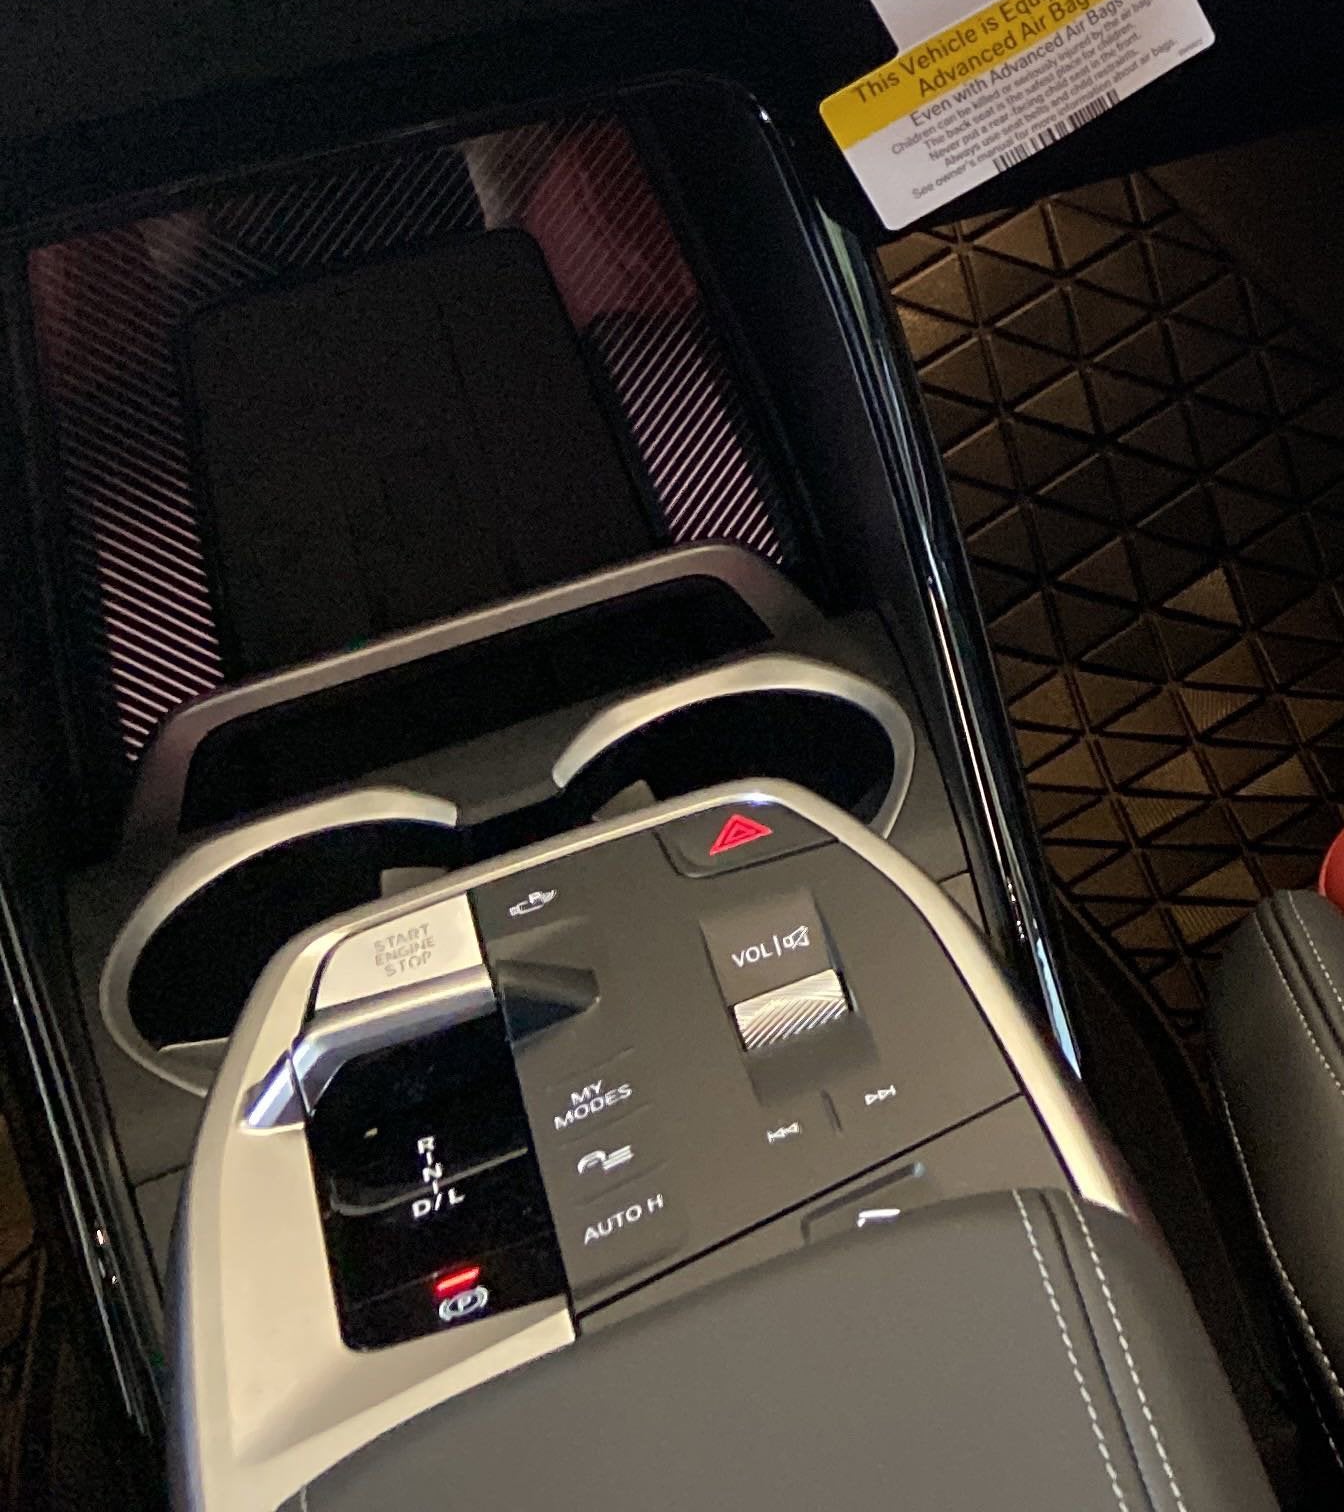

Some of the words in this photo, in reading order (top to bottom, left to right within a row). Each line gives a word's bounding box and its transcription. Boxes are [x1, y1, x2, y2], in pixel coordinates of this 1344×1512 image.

[850, 66, 900, 106] This
[898, 21, 978, 81] Vehicle
[977, 10, 999, 35] is
[908, 93, 952, 128] Even
[950, 73, 988, 106] with
[986, 30, 1064, 86] Advanced
[1062, 17, 1087, 41] Air
[913, 26, 1018, 101] Advanced
[1016, 11, 1049, 41] Air
[889, 122, 936, 156] Children
[936, 113, 958, 130] can
[956, 104, 972, 119] be
[1089, 26, 1105, 43] by
[1103, 16, 1120, 31] the
[923, 131, 945, 150] The
[944, 117, 971, 139] back
[971, 105, 995, 124] seat
[1005, 89, 1024, 105] the
[1080, 46, 1096, 61] for
[928, 136, 962, 162] Never
[960, 128, 981, 146] put
[979, 125, 988, 134] a
[943, 140, 981, 169] Always
[980, 130, 1001, 147] use
[1000, 117, 1024, 136] seat
[1049, 90, 1069, 108] and
[910, 179, 935, 200] See
[1013, 127, 1029, 142] for
[1029, 111, 1057, 133] more
[374, 923, 429, 952] START
[375, 936, 435, 966] ENGINE
[732, 941, 773, 968] VOL
[384, 951, 431, 977] STOP
[554, 1083, 632, 1130] MODES
[571, 1080, 602, 1106] MY
[417, 1136, 435, 1154] R
[422, 1162, 443, 1183] N
[584, 1204, 643, 1245] AUTO
[647, 1193, 664, 1213] H
